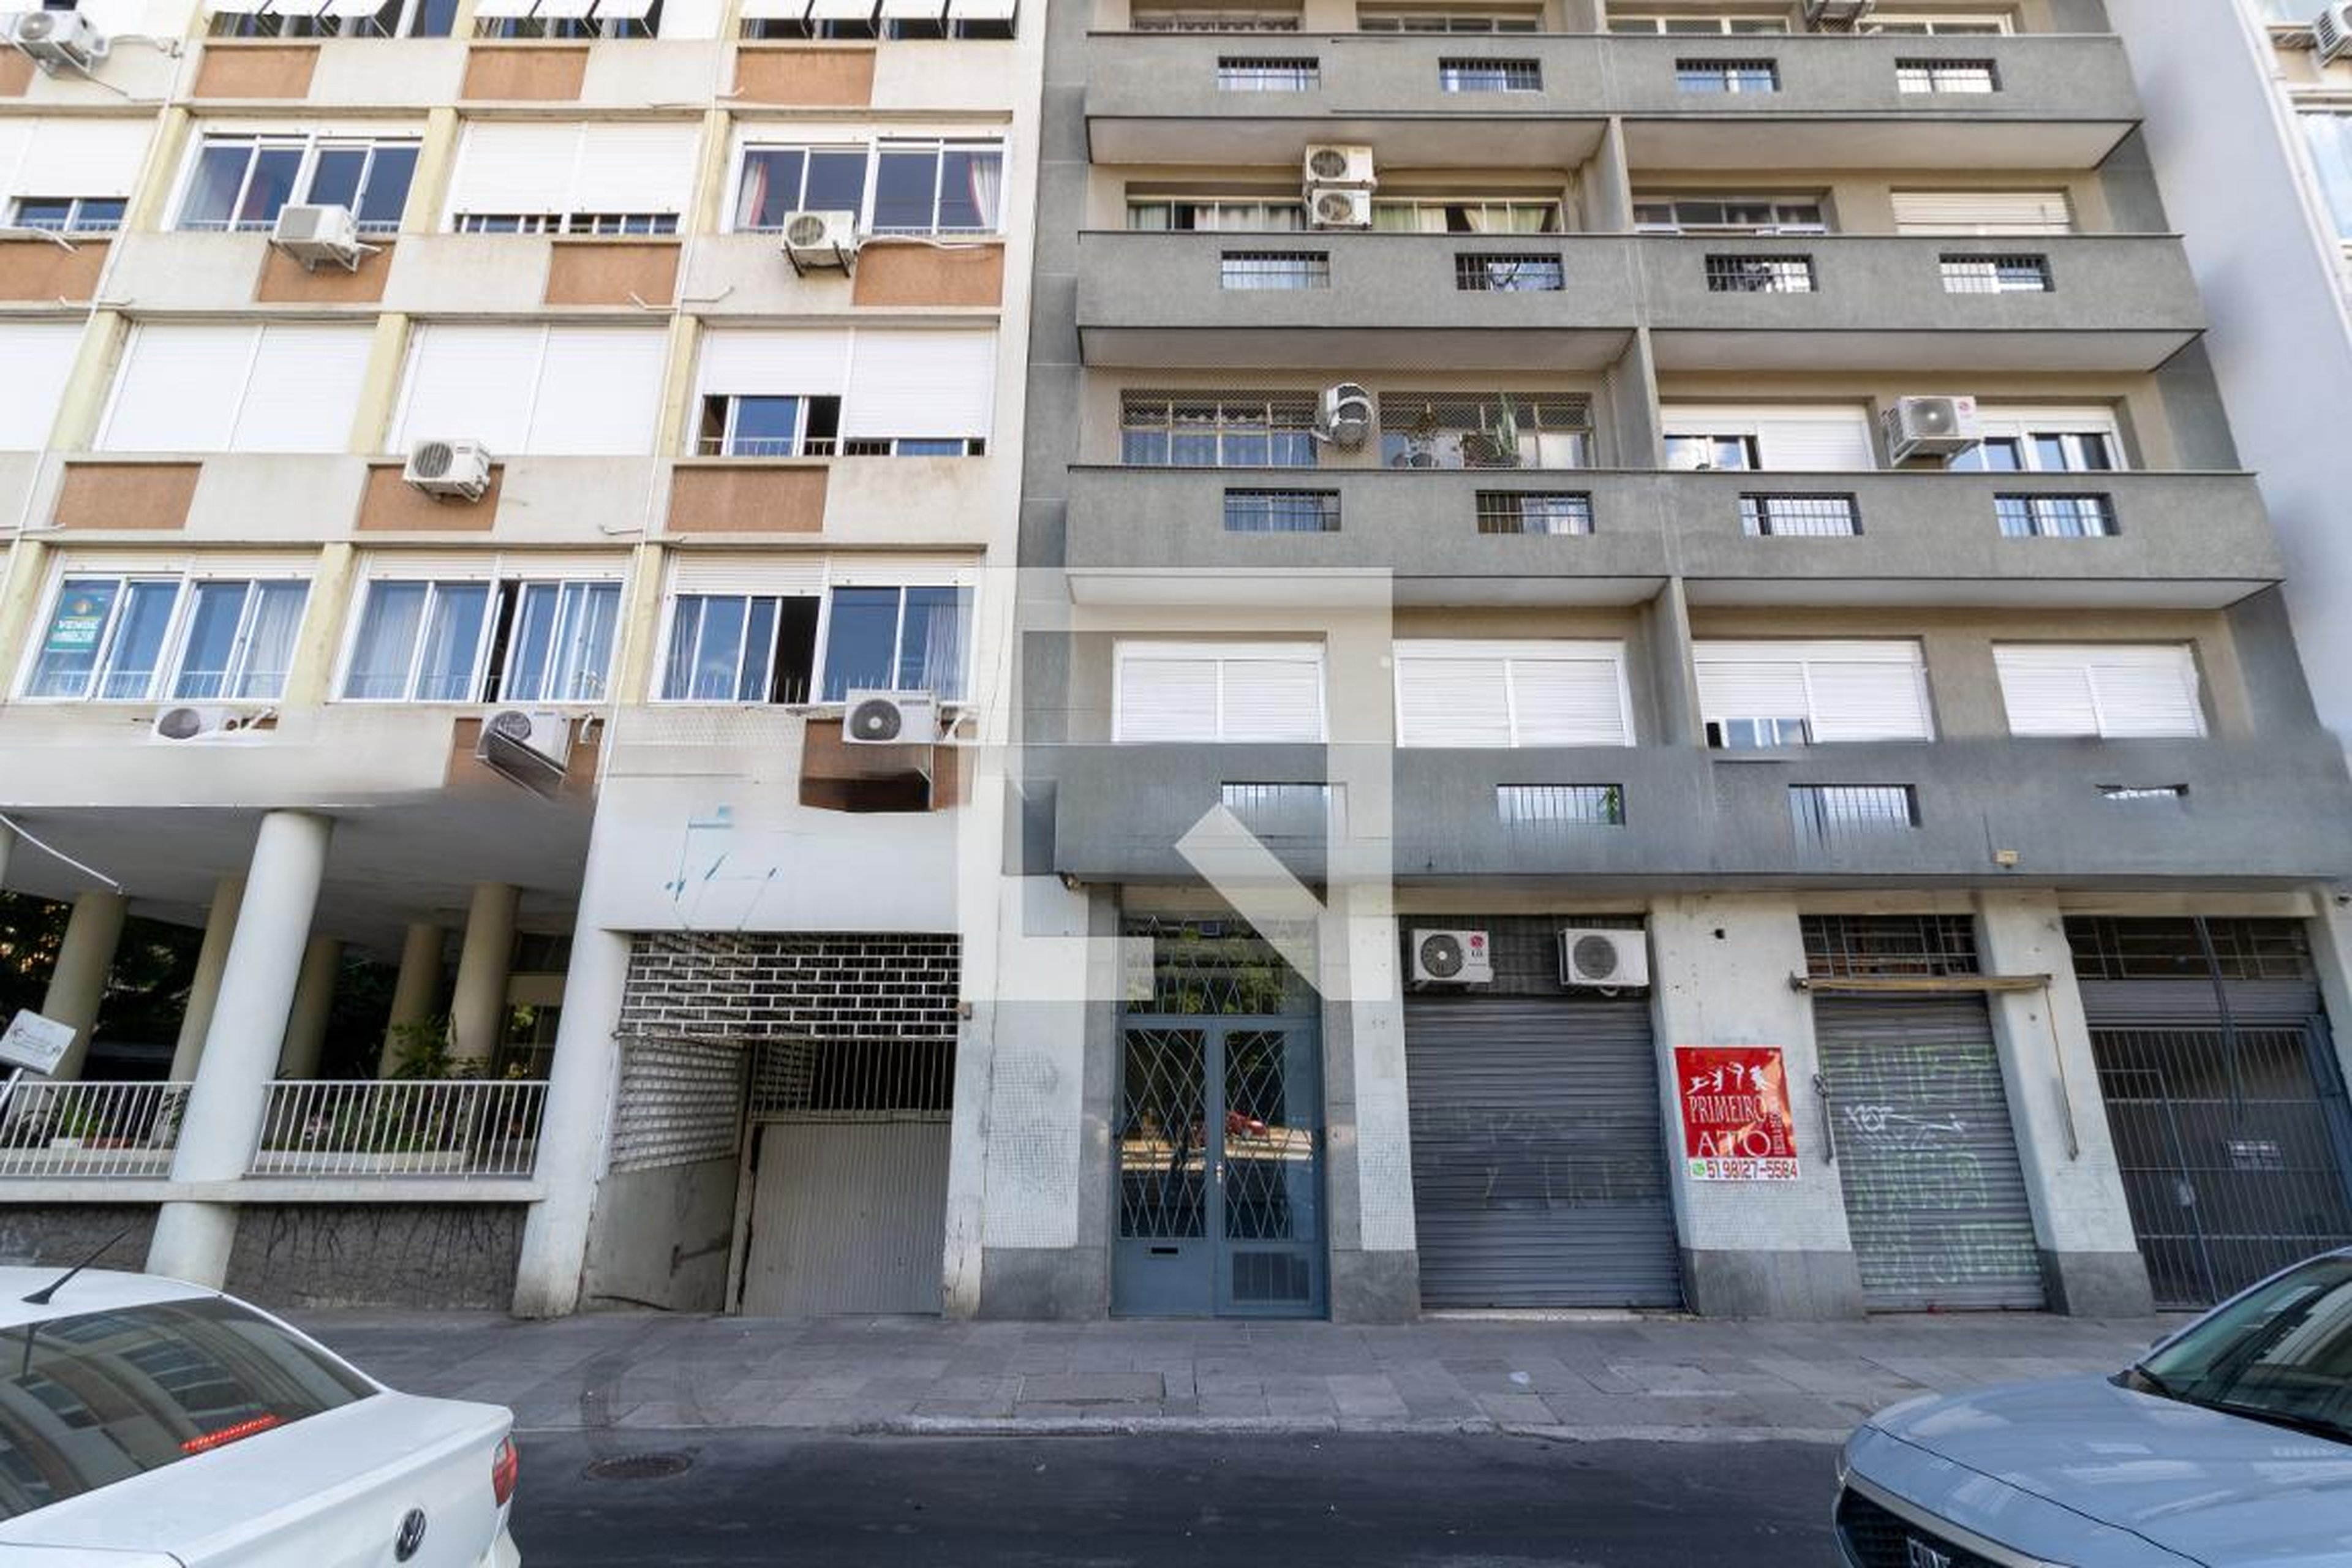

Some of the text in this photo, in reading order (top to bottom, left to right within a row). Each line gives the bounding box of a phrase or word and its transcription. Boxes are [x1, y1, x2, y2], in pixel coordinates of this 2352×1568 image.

[1688, 1095, 1767, 1123] PRIMEIRO
[1698, 1130, 1771, 1157] ATO
[1706, 1160, 1721, 1178] 51
